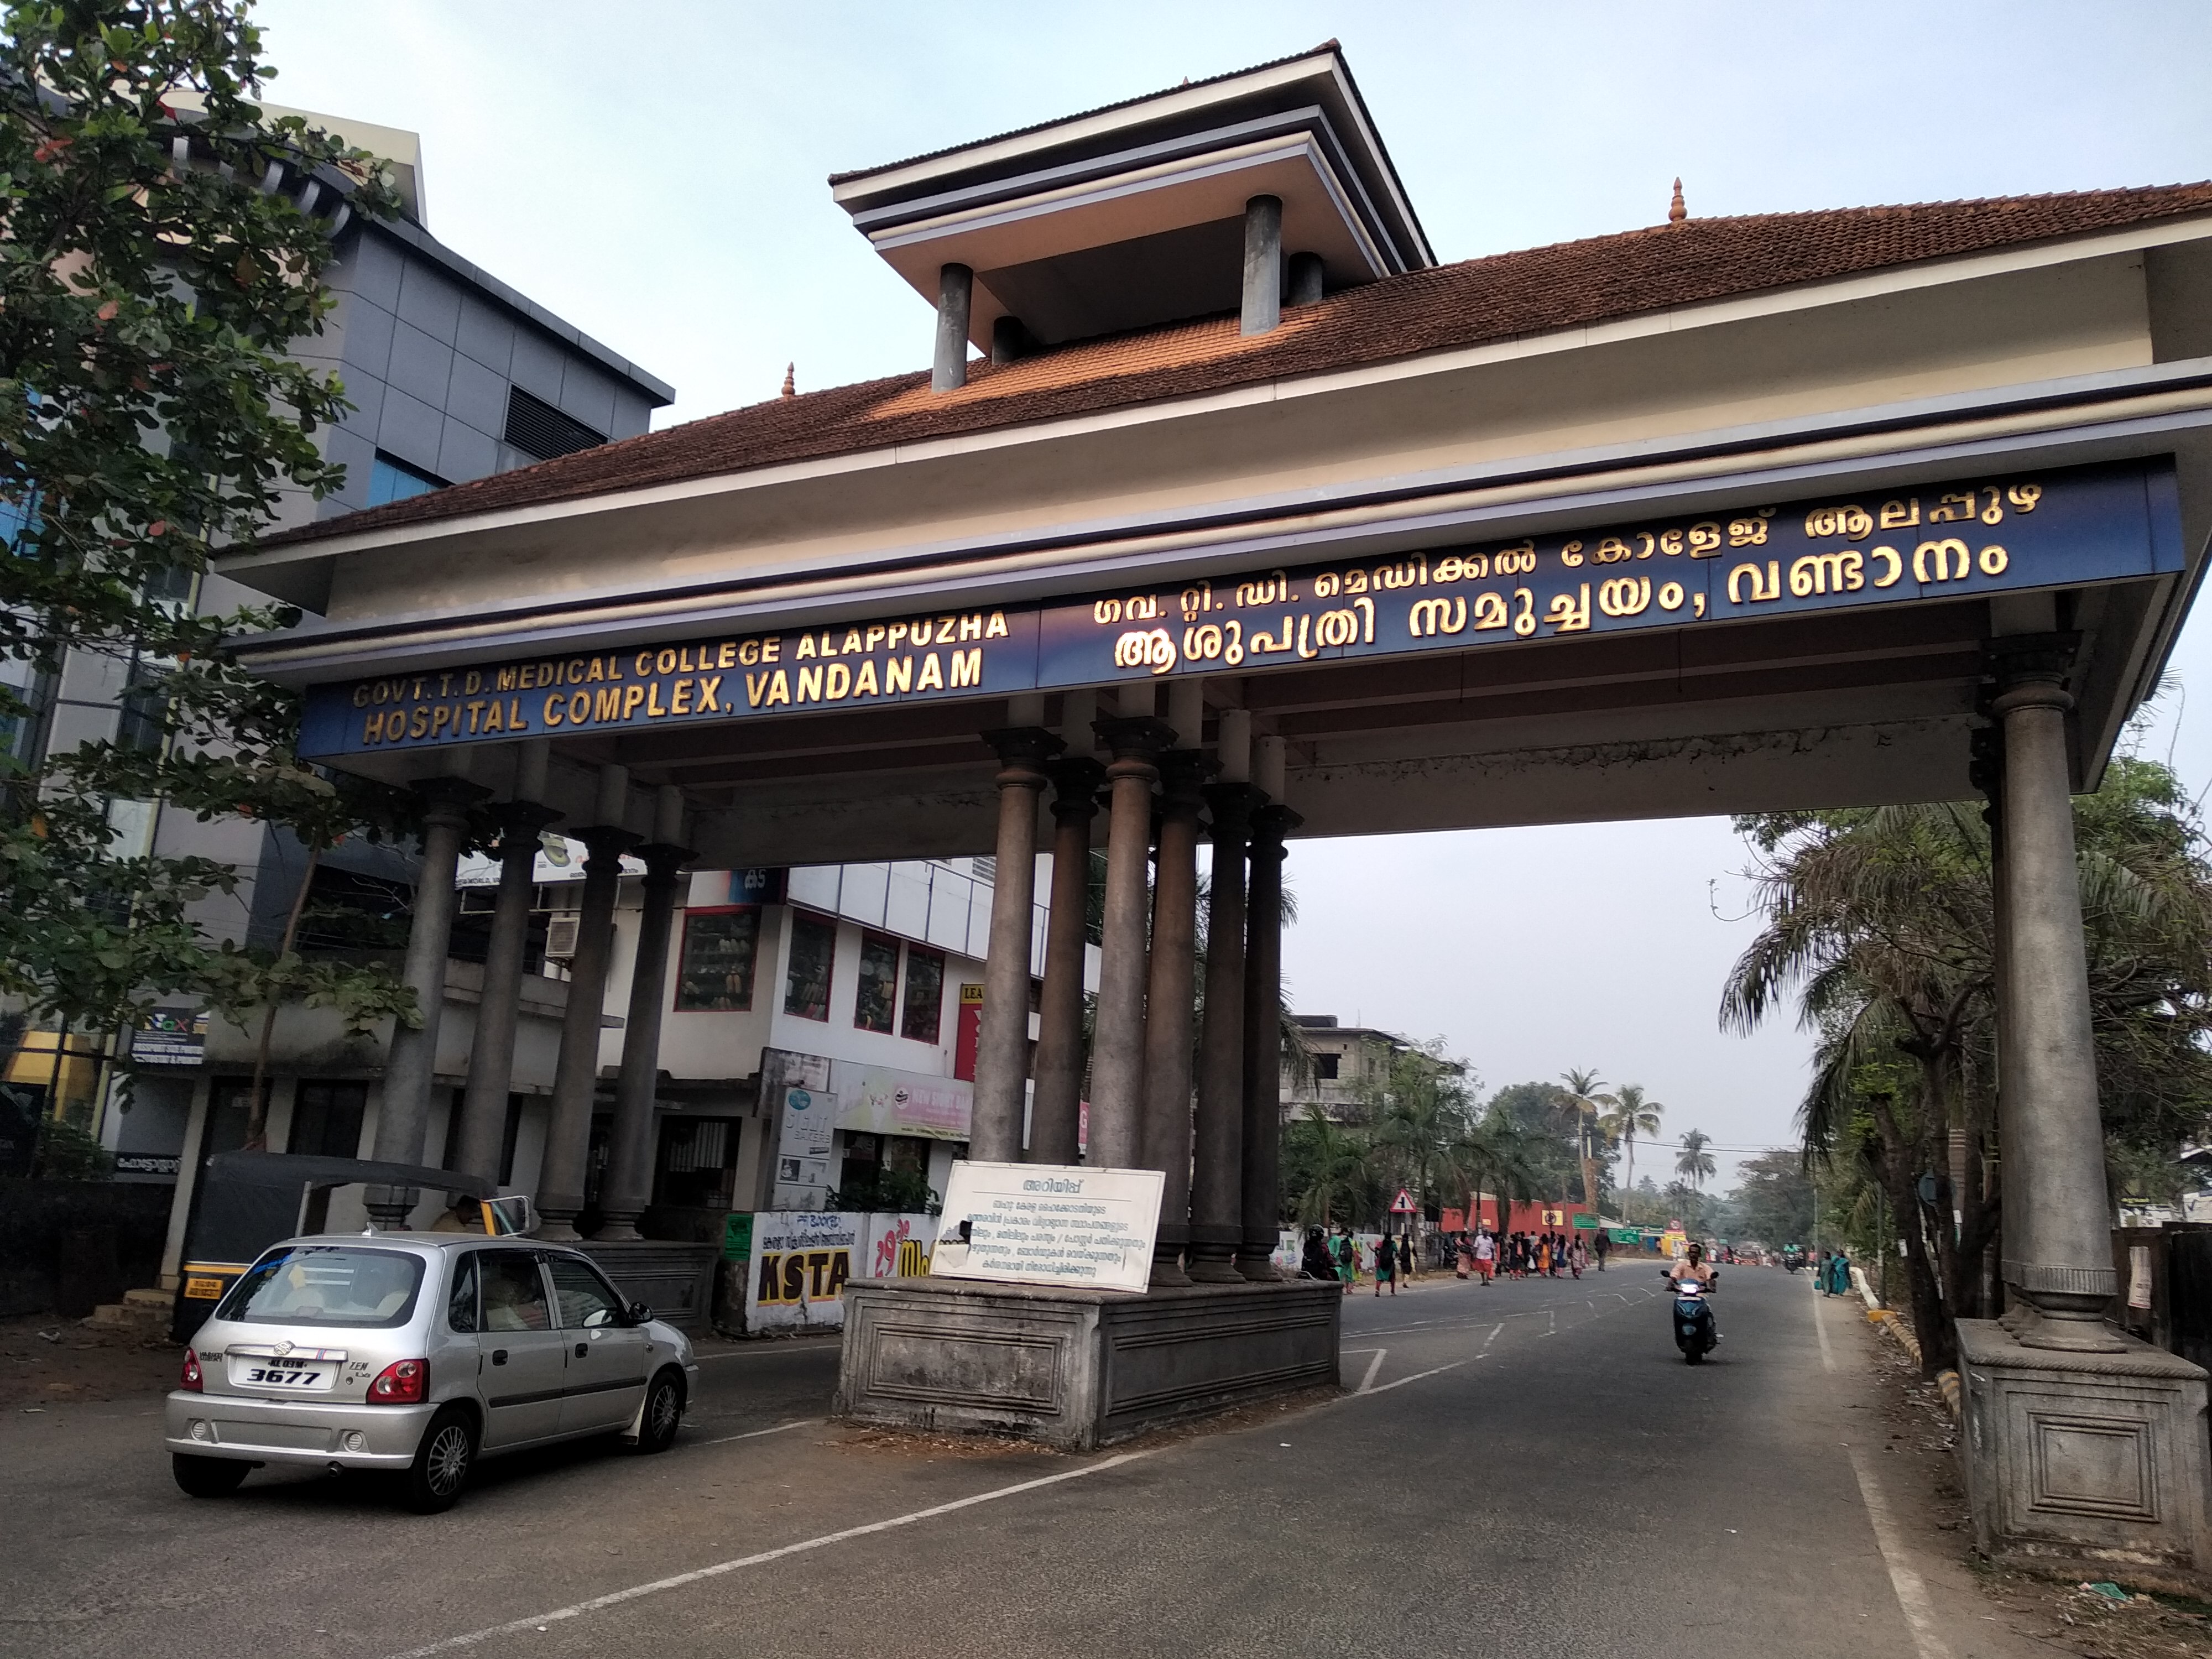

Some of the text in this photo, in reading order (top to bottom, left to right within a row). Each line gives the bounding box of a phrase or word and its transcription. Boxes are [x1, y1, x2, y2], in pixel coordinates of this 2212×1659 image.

[1094, 594, 1167, 625] ഗവ.
[1237, 570, 1299, 607] ഡി.
[1315, 539, 1537, 598] മെഡിക്കൽ
[1562, 508, 1776, 566] കോളേജ്
[1805, 482, 2043, 541] ആലപ്പുഴ
[1114, 538, 2010, 675] ആശുപത്രി സമുച്ചയം, വണ്ടാനം
[497, 656, 623, 691] MEDICAL
[635, 637, 781, 677] COLLEGE
[795, 609, 1009, 660] ALAPPUZHA
[363, 648, 983, 745] HOSPITAL COMPLEX, VANDANAM
[1023, 1178, 1084, 1194] അറിയിപ്പ്
[757, 1250, 850, 1307] KSTA
[246, 1369, 321, 1386] 3677
[348, 1361, 369, 1371] ZEN
